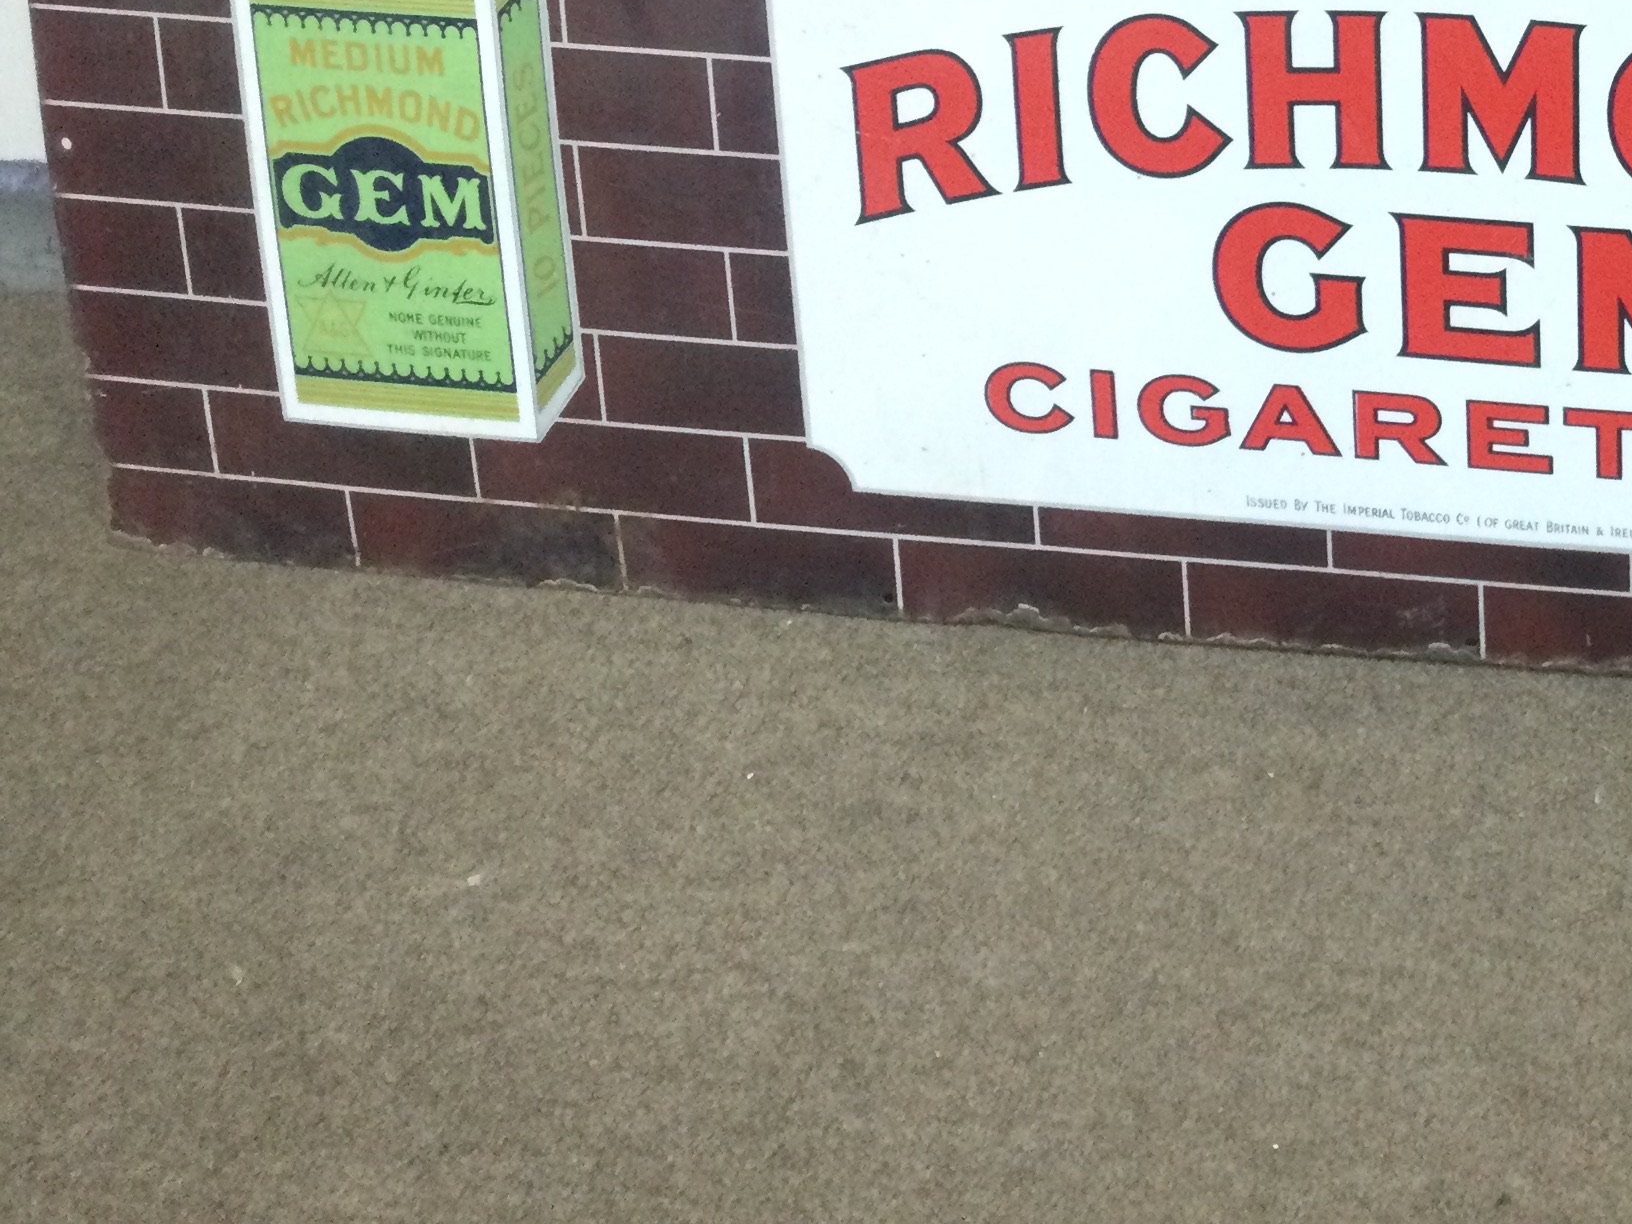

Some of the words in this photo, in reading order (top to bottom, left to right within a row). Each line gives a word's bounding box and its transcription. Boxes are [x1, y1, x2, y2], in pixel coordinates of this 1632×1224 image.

[289, 39, 445, 75] MEDIUM
[270, 85, 481, 142] RICHMOND
[511, 61, 552, 235] PIECES
[281, 163, 487, 231] GEM
[412, 330, 466, 344] WITHOUT
[428, 314, 482, 328] GENUINE
[387, 344, 416, 357] THIS
[422, 345, 493, 362] SIGNATURE
[1246, 495, 1287, 510] ISSUED
[1294, 498, 1309, 511] BY
[1314, 500, 1337, 514] THE
[1343, 503, 1395, 519] IMPERIAL
[1401, 507, 1451, 524] TOBACCO
[1504, 518, 1539, 531] GREAT
[1546, 520, 1589, 536] BRITAIN
[1596, 524, 1604, 536] &
